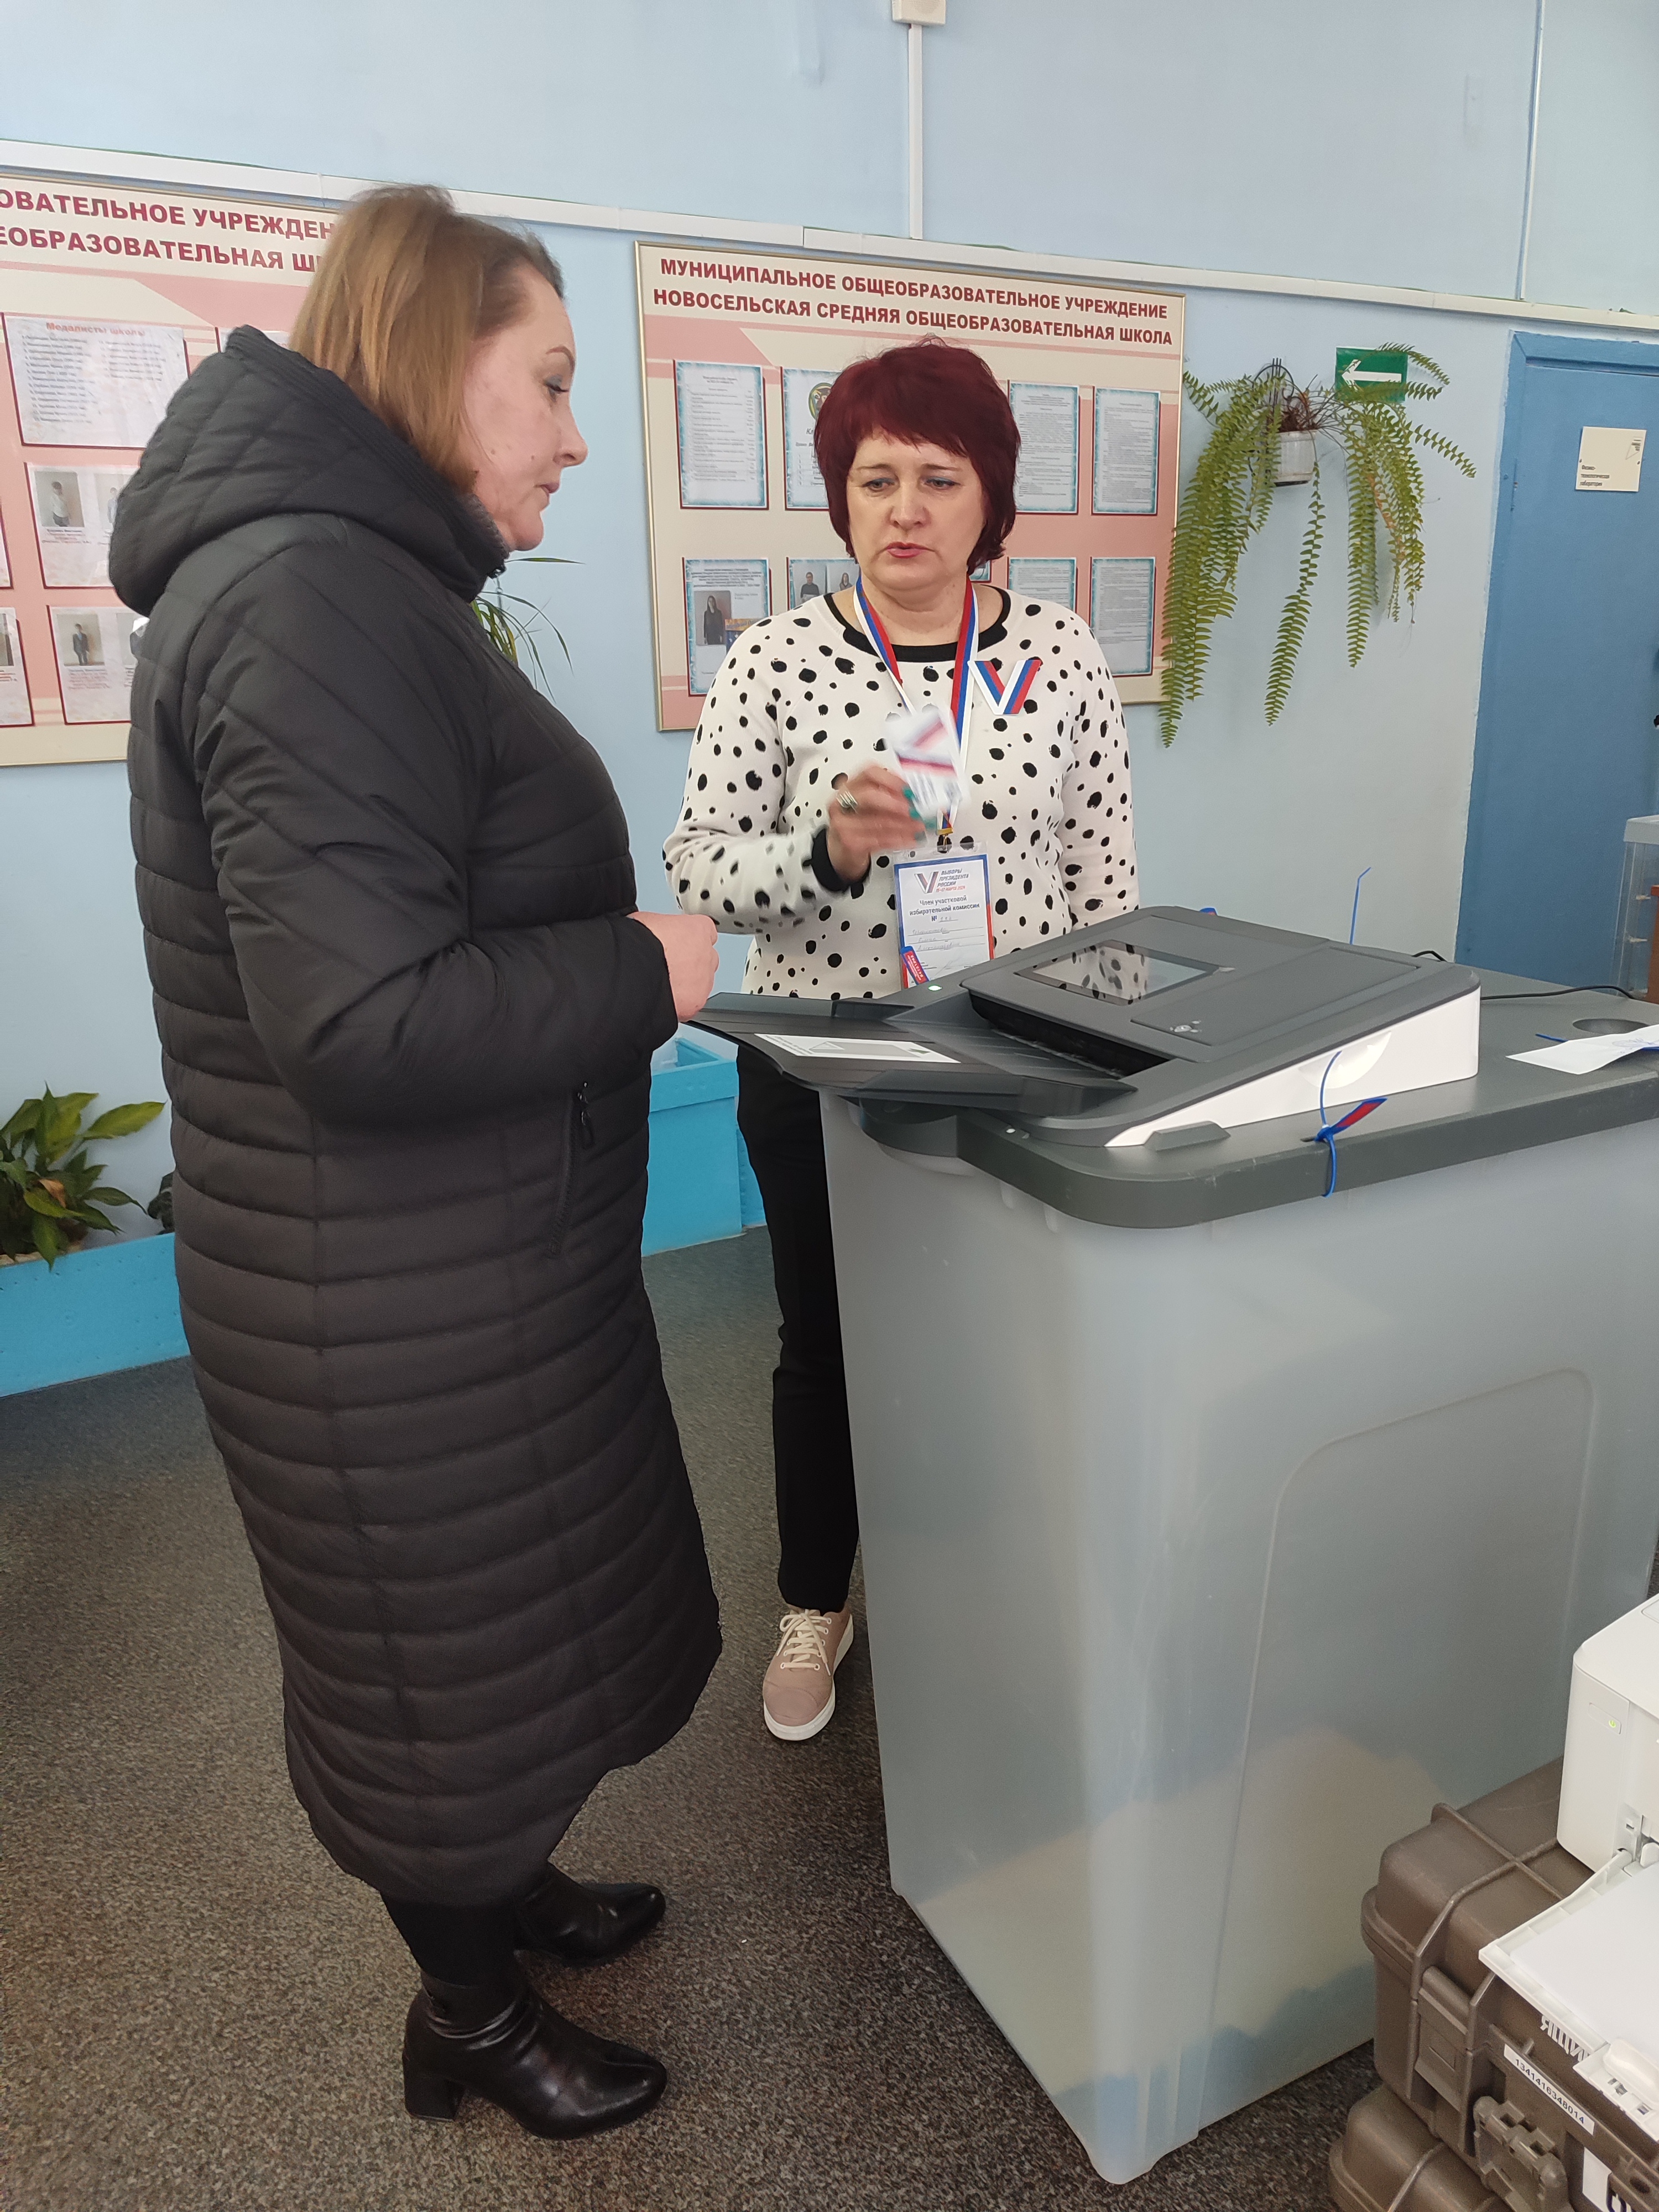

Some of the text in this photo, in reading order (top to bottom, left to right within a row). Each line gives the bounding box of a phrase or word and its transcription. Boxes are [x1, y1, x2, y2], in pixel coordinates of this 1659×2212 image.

[660, 258, 1167, 319] МУНИЦИПАЛЬНОЕ ОБЩЕОБРАЗОВАТЕЛЬНОЕ УЧРЕЖДЕНИЕ
[46, 322, 107, 333] Медалисты
[653, 288, 1172, 345] НОВОСЕЛЬСКАЯ СРЕДНЯЯ ОБЩЕОБРАЗОВАТЕЛЬНАЯ ШКОЛА
[909, 905, 952, 916] избирательной
[935, 895, 967, 906] участковой
[1515, 2058, 1585, 2125] 1341416348014
